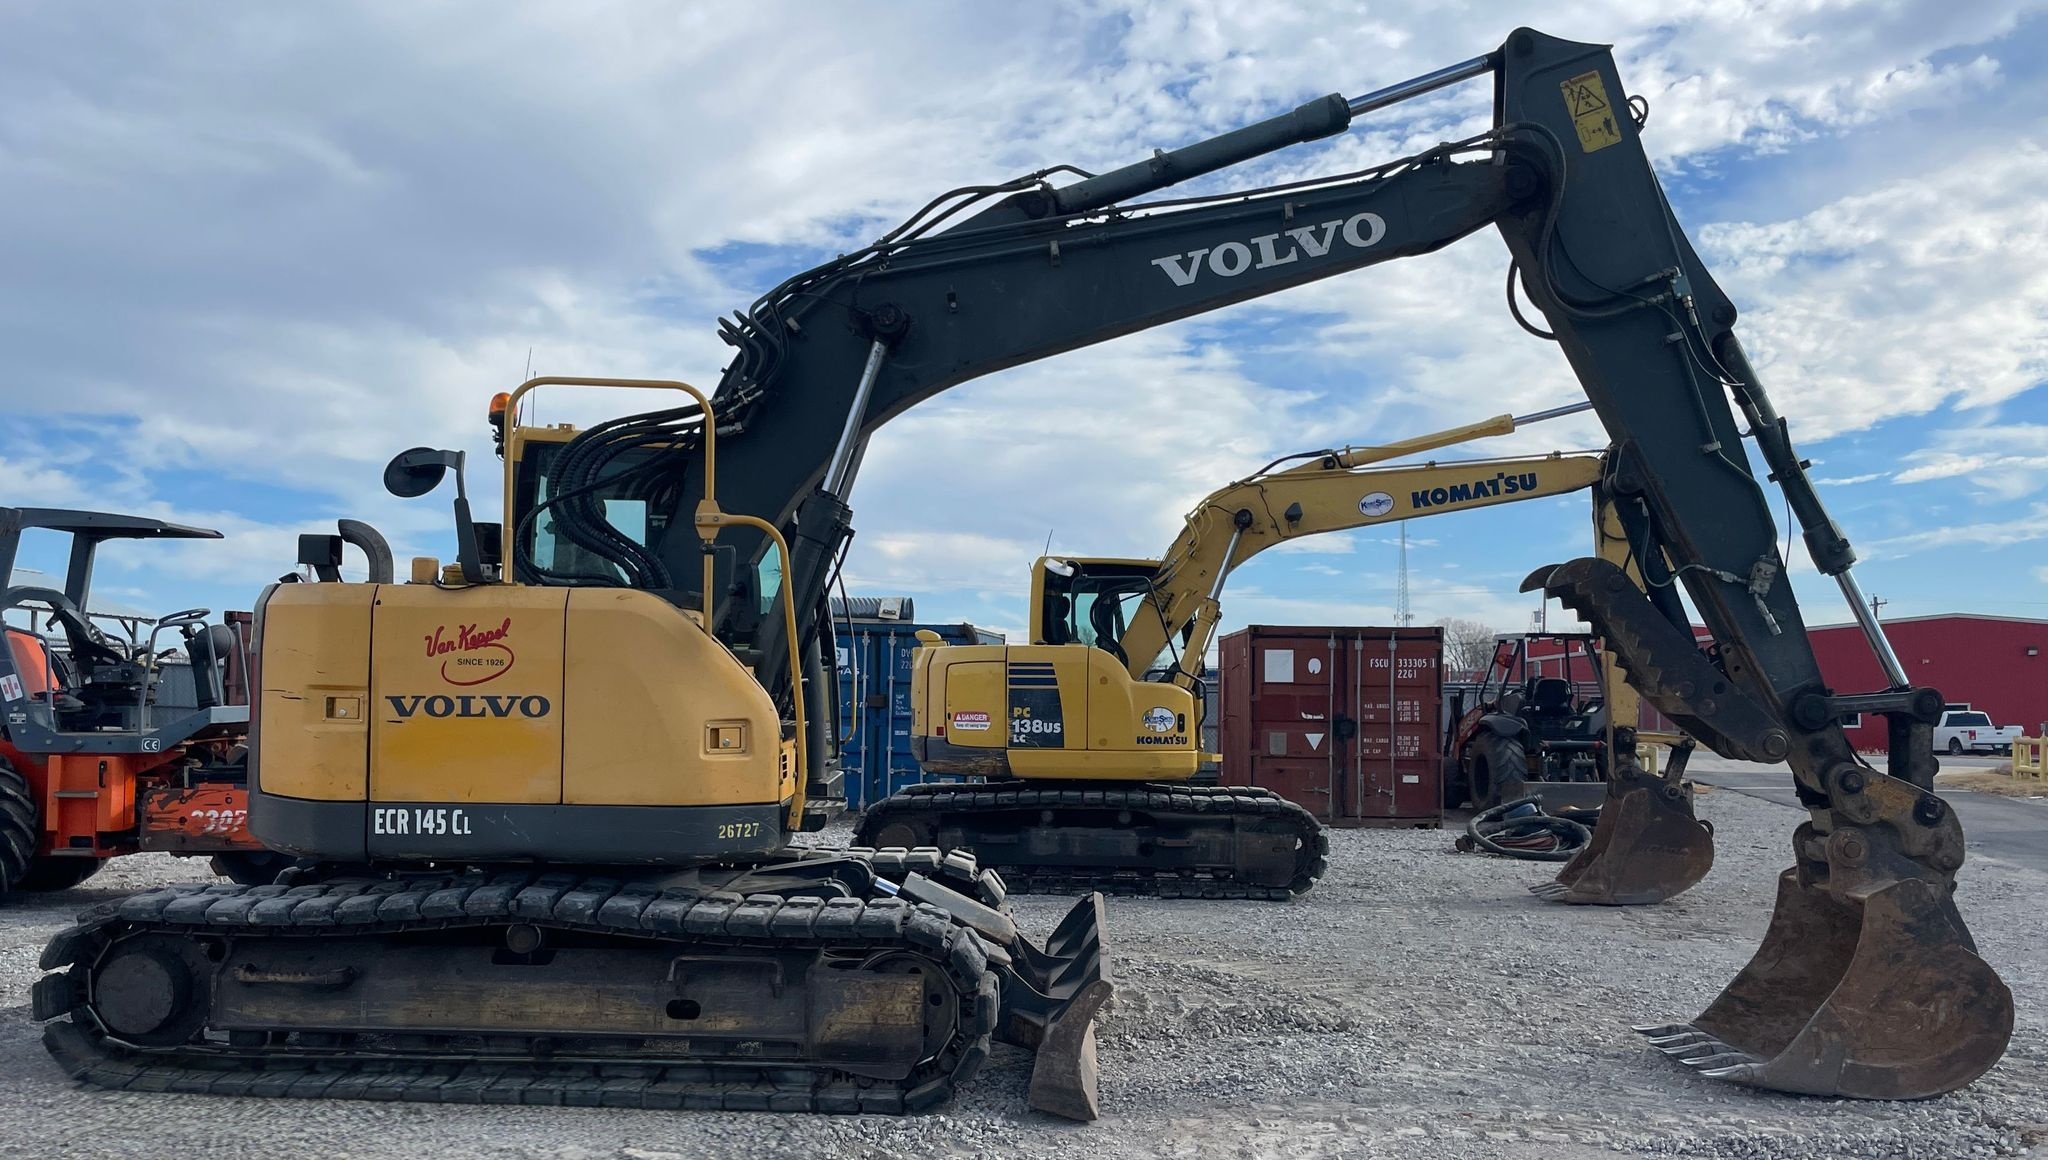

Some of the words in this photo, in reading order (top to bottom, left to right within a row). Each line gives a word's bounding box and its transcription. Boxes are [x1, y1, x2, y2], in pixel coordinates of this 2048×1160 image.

[1151, 212, 1387, 286] VOLVO
[1411, 472, 1538, 508] KOMATSU
[425, 626, 456, 657] Van
[458, 617, 511, 651] Keppel
[457, 658, 483, 666] SINCE
[1370, 658, 1389, 668] FSCU
[1398, 658, 1427, 668] 333305
[1398, 669, 1417, 678] 22G1
[385, 695, 551, 717] VOLVO
[1013, 707, 1031, 717] PC
[1013, 734, 1026, 742] LC
[1137, 734, 1187, 744] KOMATSU
[144, 740, 158, 750] CE
[375, 809, 409, 834] ECR
[415, 809, 447, 834] 145
[719, 822, 760, 839] 26727
